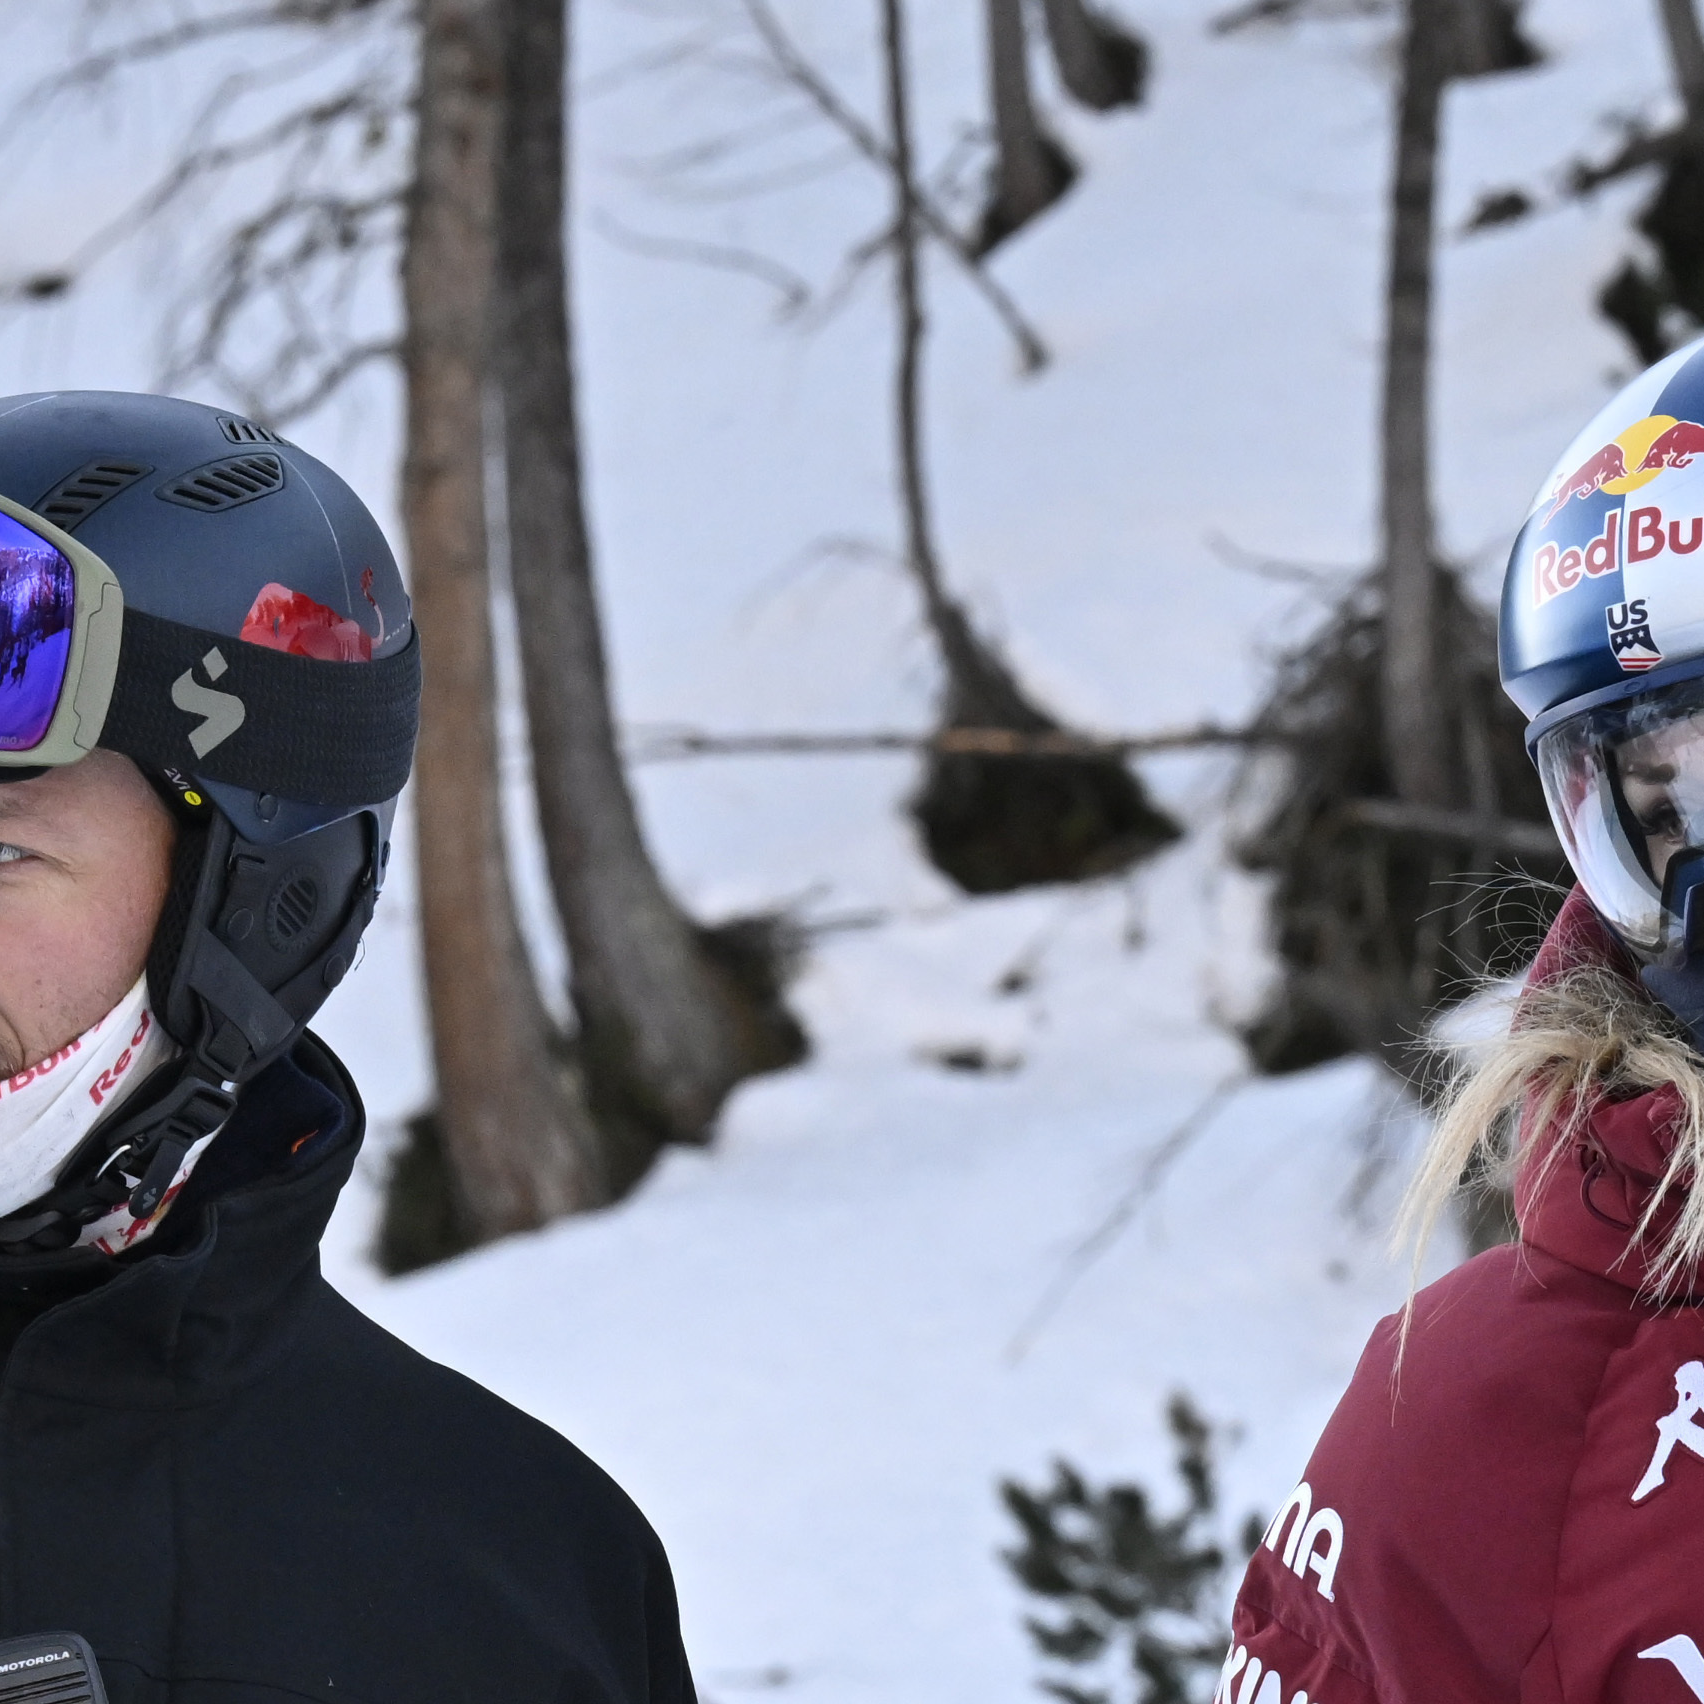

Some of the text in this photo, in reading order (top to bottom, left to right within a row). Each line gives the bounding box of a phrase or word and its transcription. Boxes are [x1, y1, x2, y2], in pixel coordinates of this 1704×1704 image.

[1534, 509, 1620, 606] Red
[1607, 599, 1648, 630] US
[89, 1009, 151, 1106] Red
